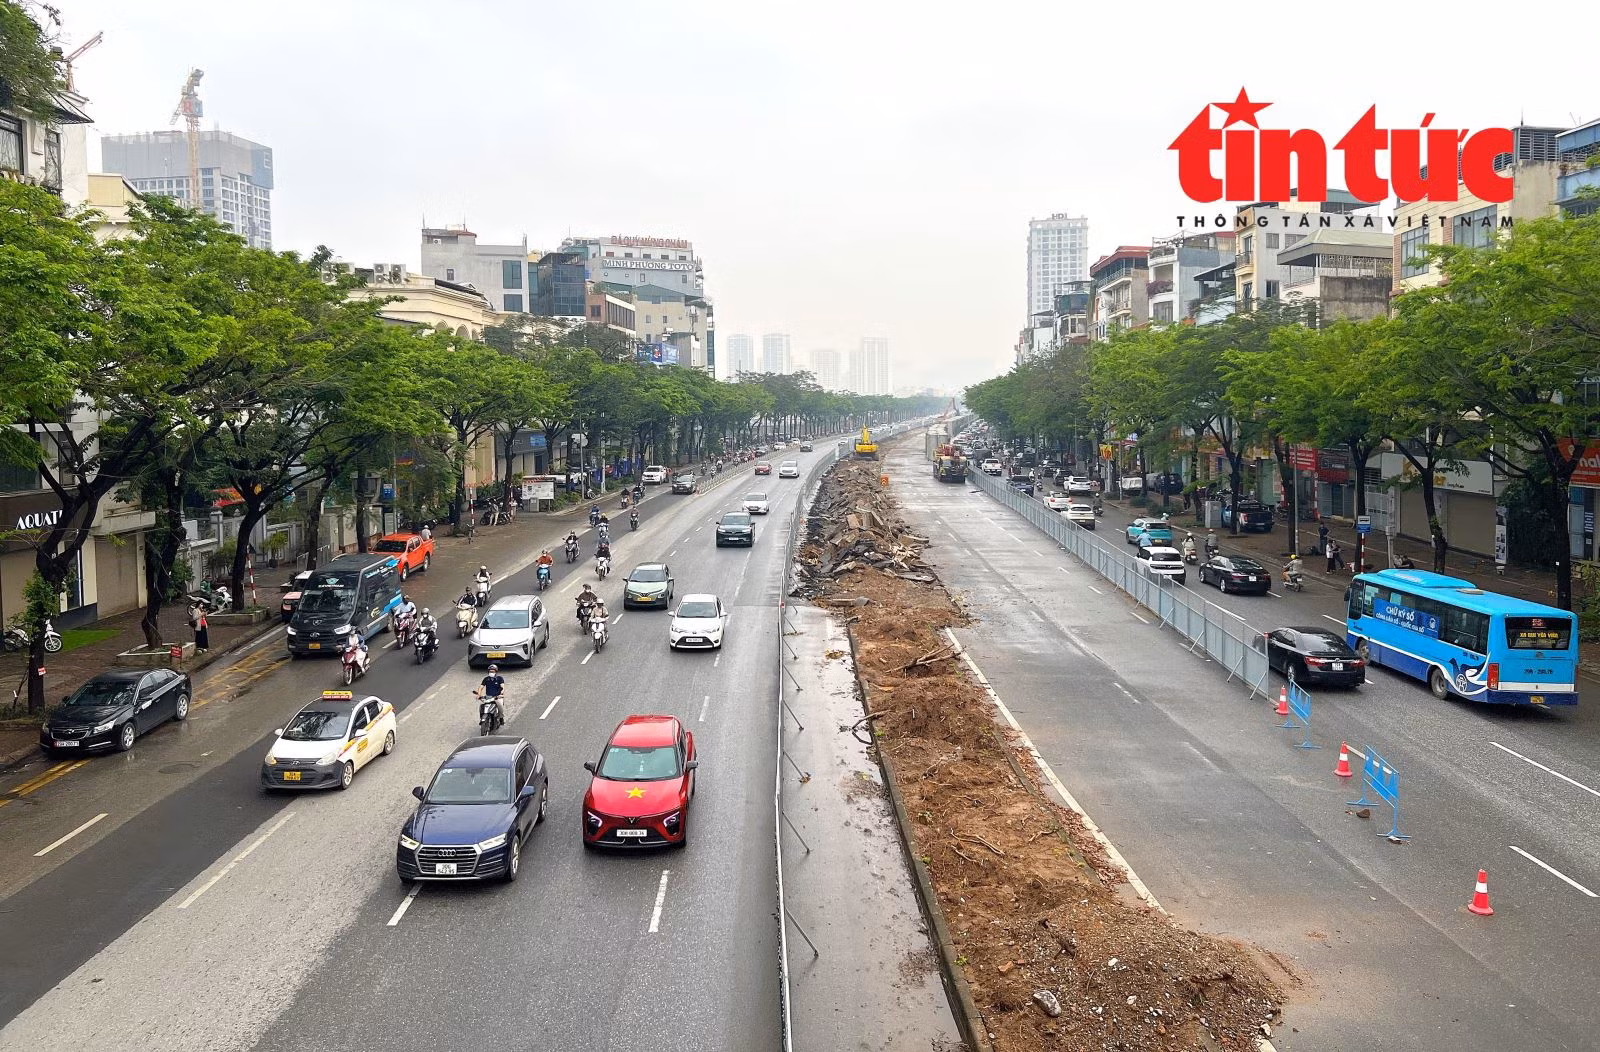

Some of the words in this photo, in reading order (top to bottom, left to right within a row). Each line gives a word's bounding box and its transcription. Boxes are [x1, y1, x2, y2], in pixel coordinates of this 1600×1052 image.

[602, 260, 628, 269] MINH
[668, 262, 694, 271] TOTO
[1386, 606, 1398, 616] CHỮ
[1406, 611, 1415, 621] SỐ
